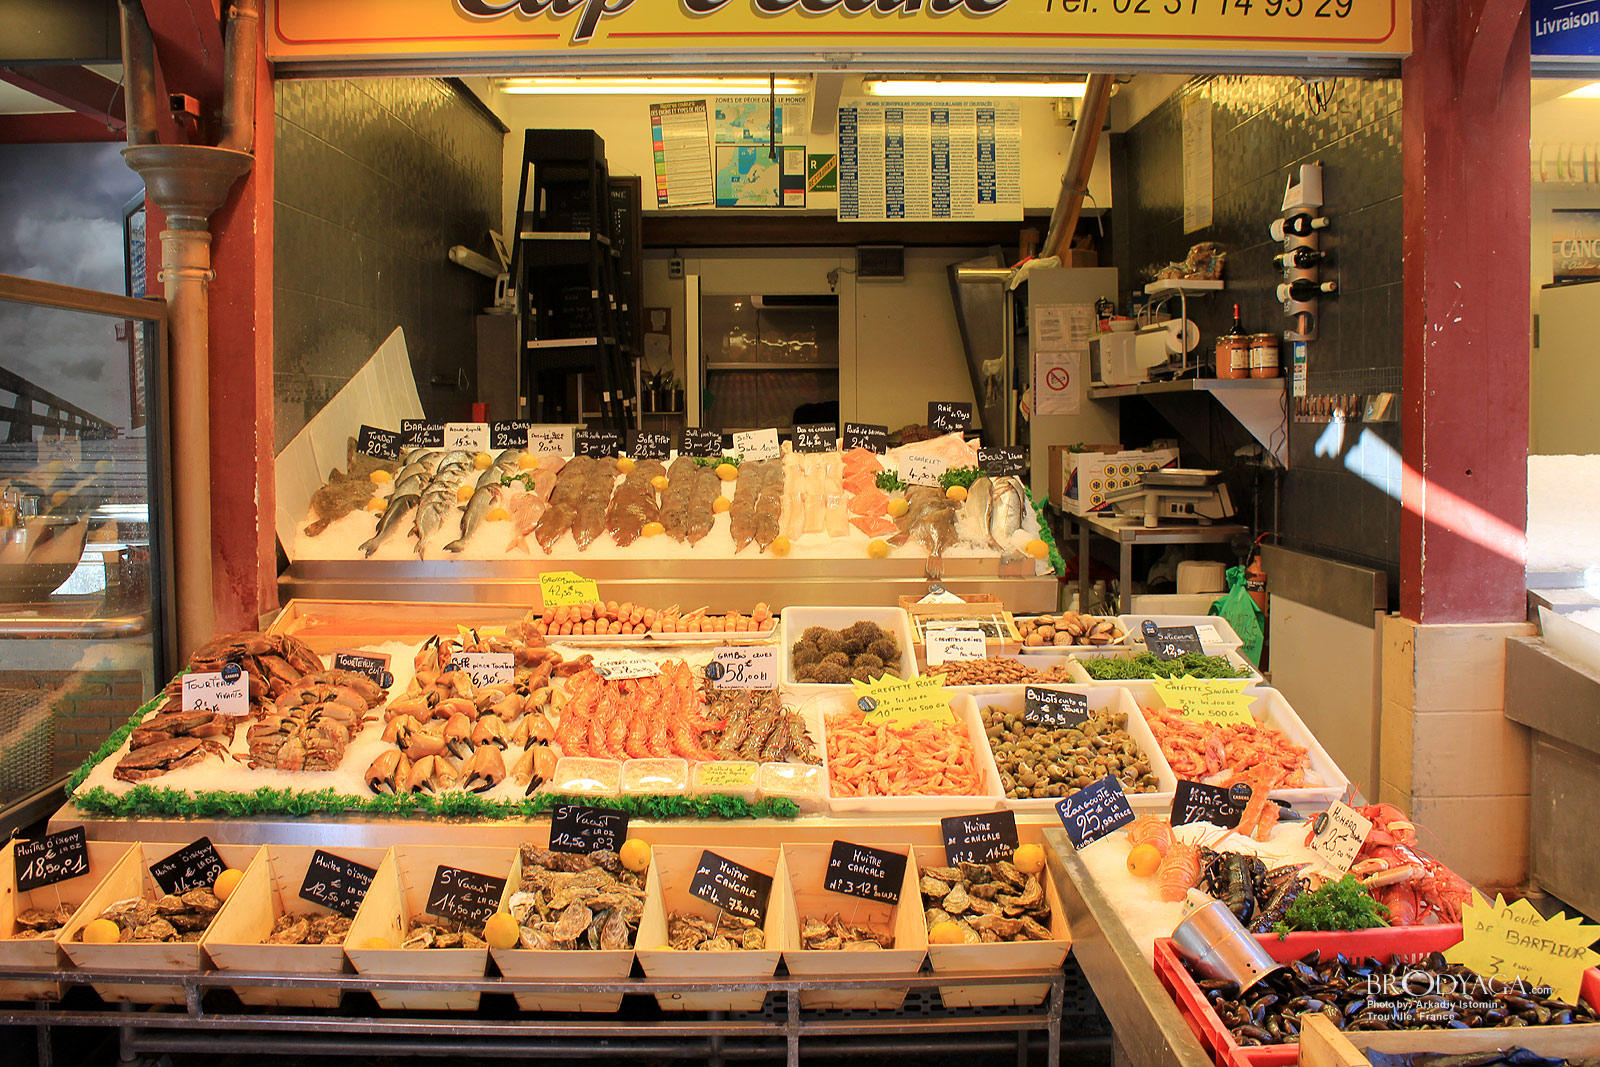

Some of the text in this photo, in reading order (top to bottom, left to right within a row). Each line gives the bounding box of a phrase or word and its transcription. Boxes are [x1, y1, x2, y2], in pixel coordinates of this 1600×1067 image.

[1535, 10, 1600, 37] Livraison
[963, 832, 1001, 844] CANCALE
[847, 863, 886, 879] CANCALE
[714, 873, 757, 899] CANCALE
[1505, 929, 1587, 960] BARFLEUR
[1488, 955, 1504, 975] 3
